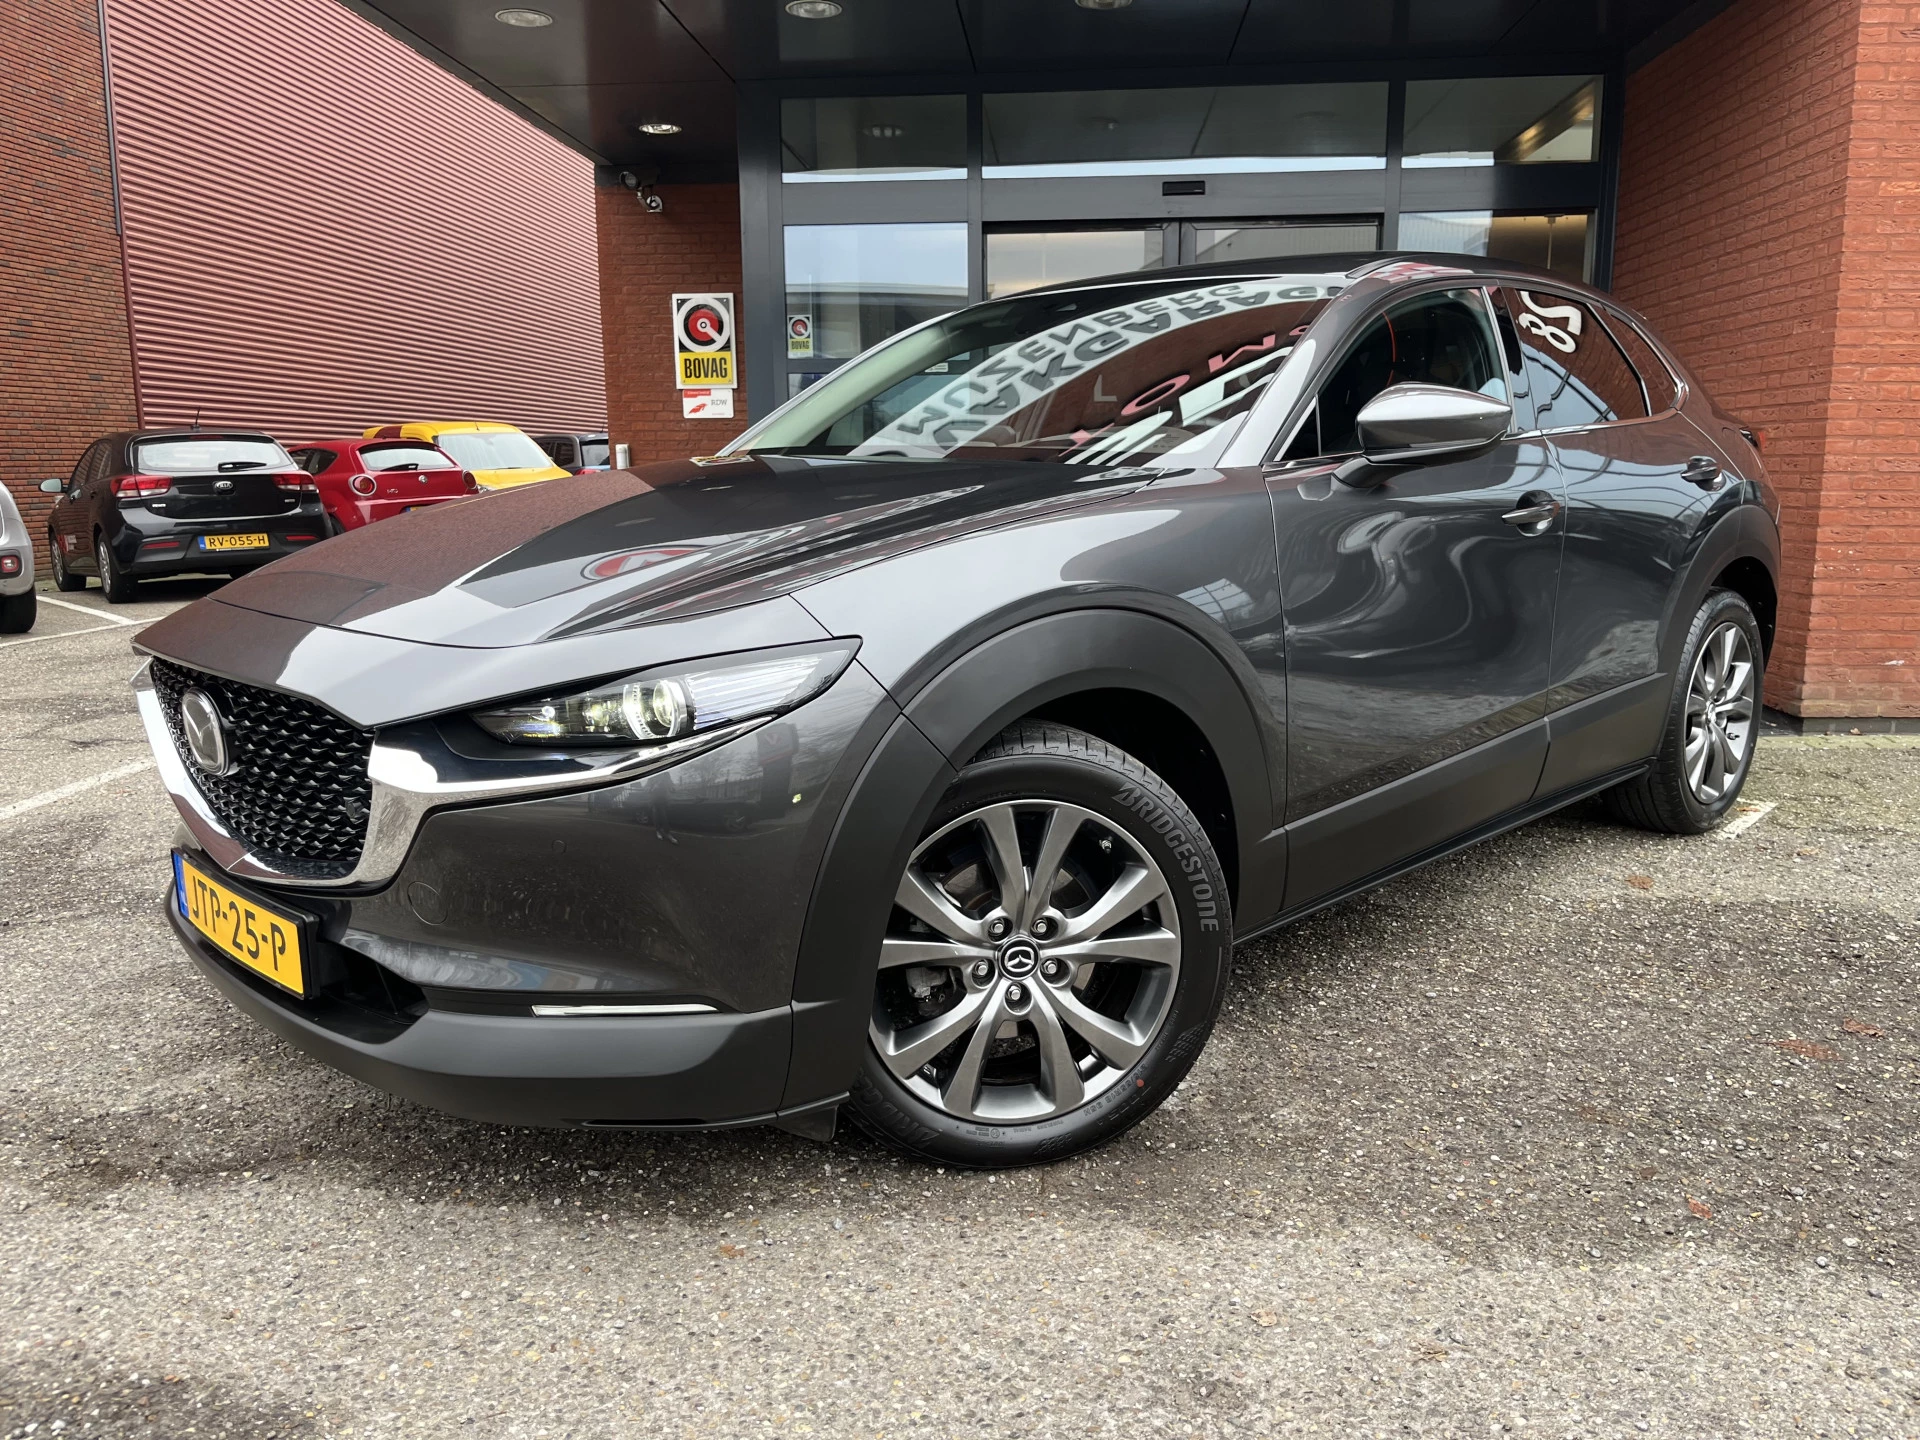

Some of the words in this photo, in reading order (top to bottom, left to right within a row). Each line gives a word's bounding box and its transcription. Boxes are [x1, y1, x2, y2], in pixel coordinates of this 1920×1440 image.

[791, 340, 810, 350] BOVAG
[684, 358, 728, 379] BOVAG
[208, 535, 266, 547] RV-055-H
[1112, 782, 1219, 931] BRIDGESTONE
[192, 875, 286, 971] JTP-25-P
